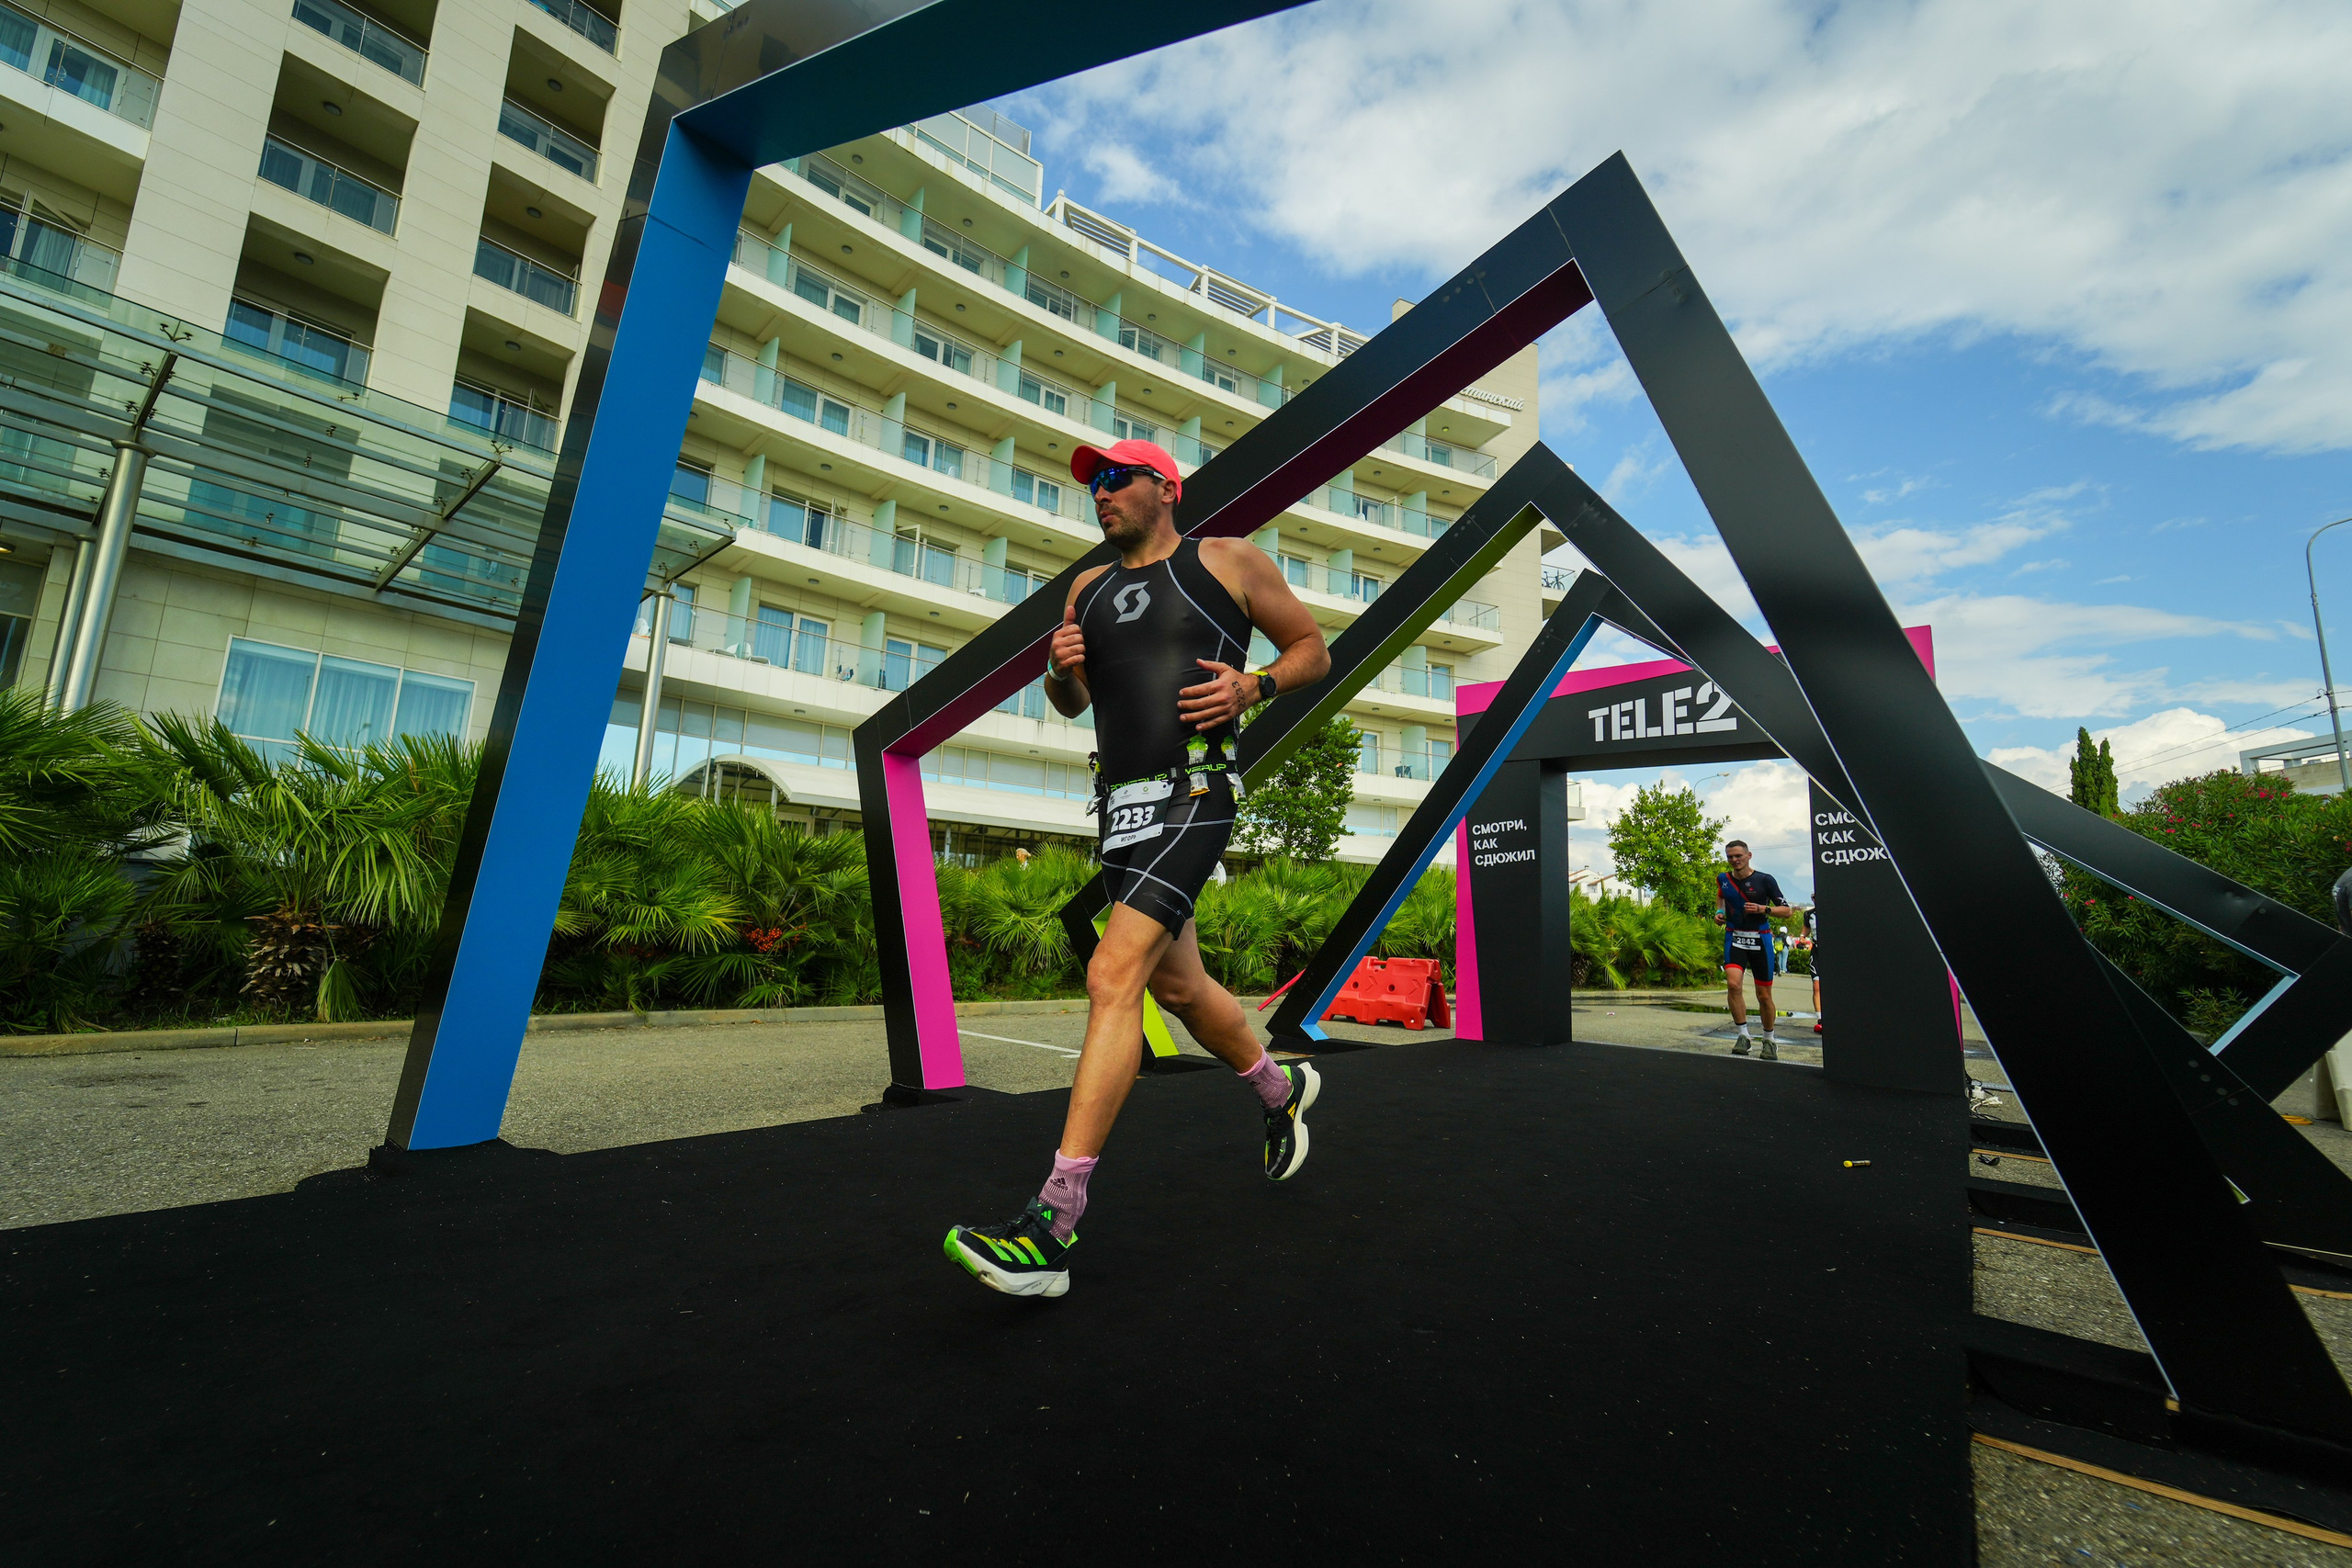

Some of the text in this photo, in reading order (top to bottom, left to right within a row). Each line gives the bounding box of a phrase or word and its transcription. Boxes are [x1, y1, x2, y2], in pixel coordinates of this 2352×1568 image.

[1589, 681, 1737, 742] TELE2
[1110, 805, 1156, 834] 2233
[1472, 819, 1527, 835] СМОТРИ,
[1121, 834, 1136, 842] ИГОРЬ
[1474, 838, 1498, 851] КАК
[1818, 829, 1856, 845] КАК
[1475, 849, 1536, 867] СДЮЖИЛ
[1821, 846, 1892, 865] СДЮЖ
[1736, 937, 1756, 945] 2842
